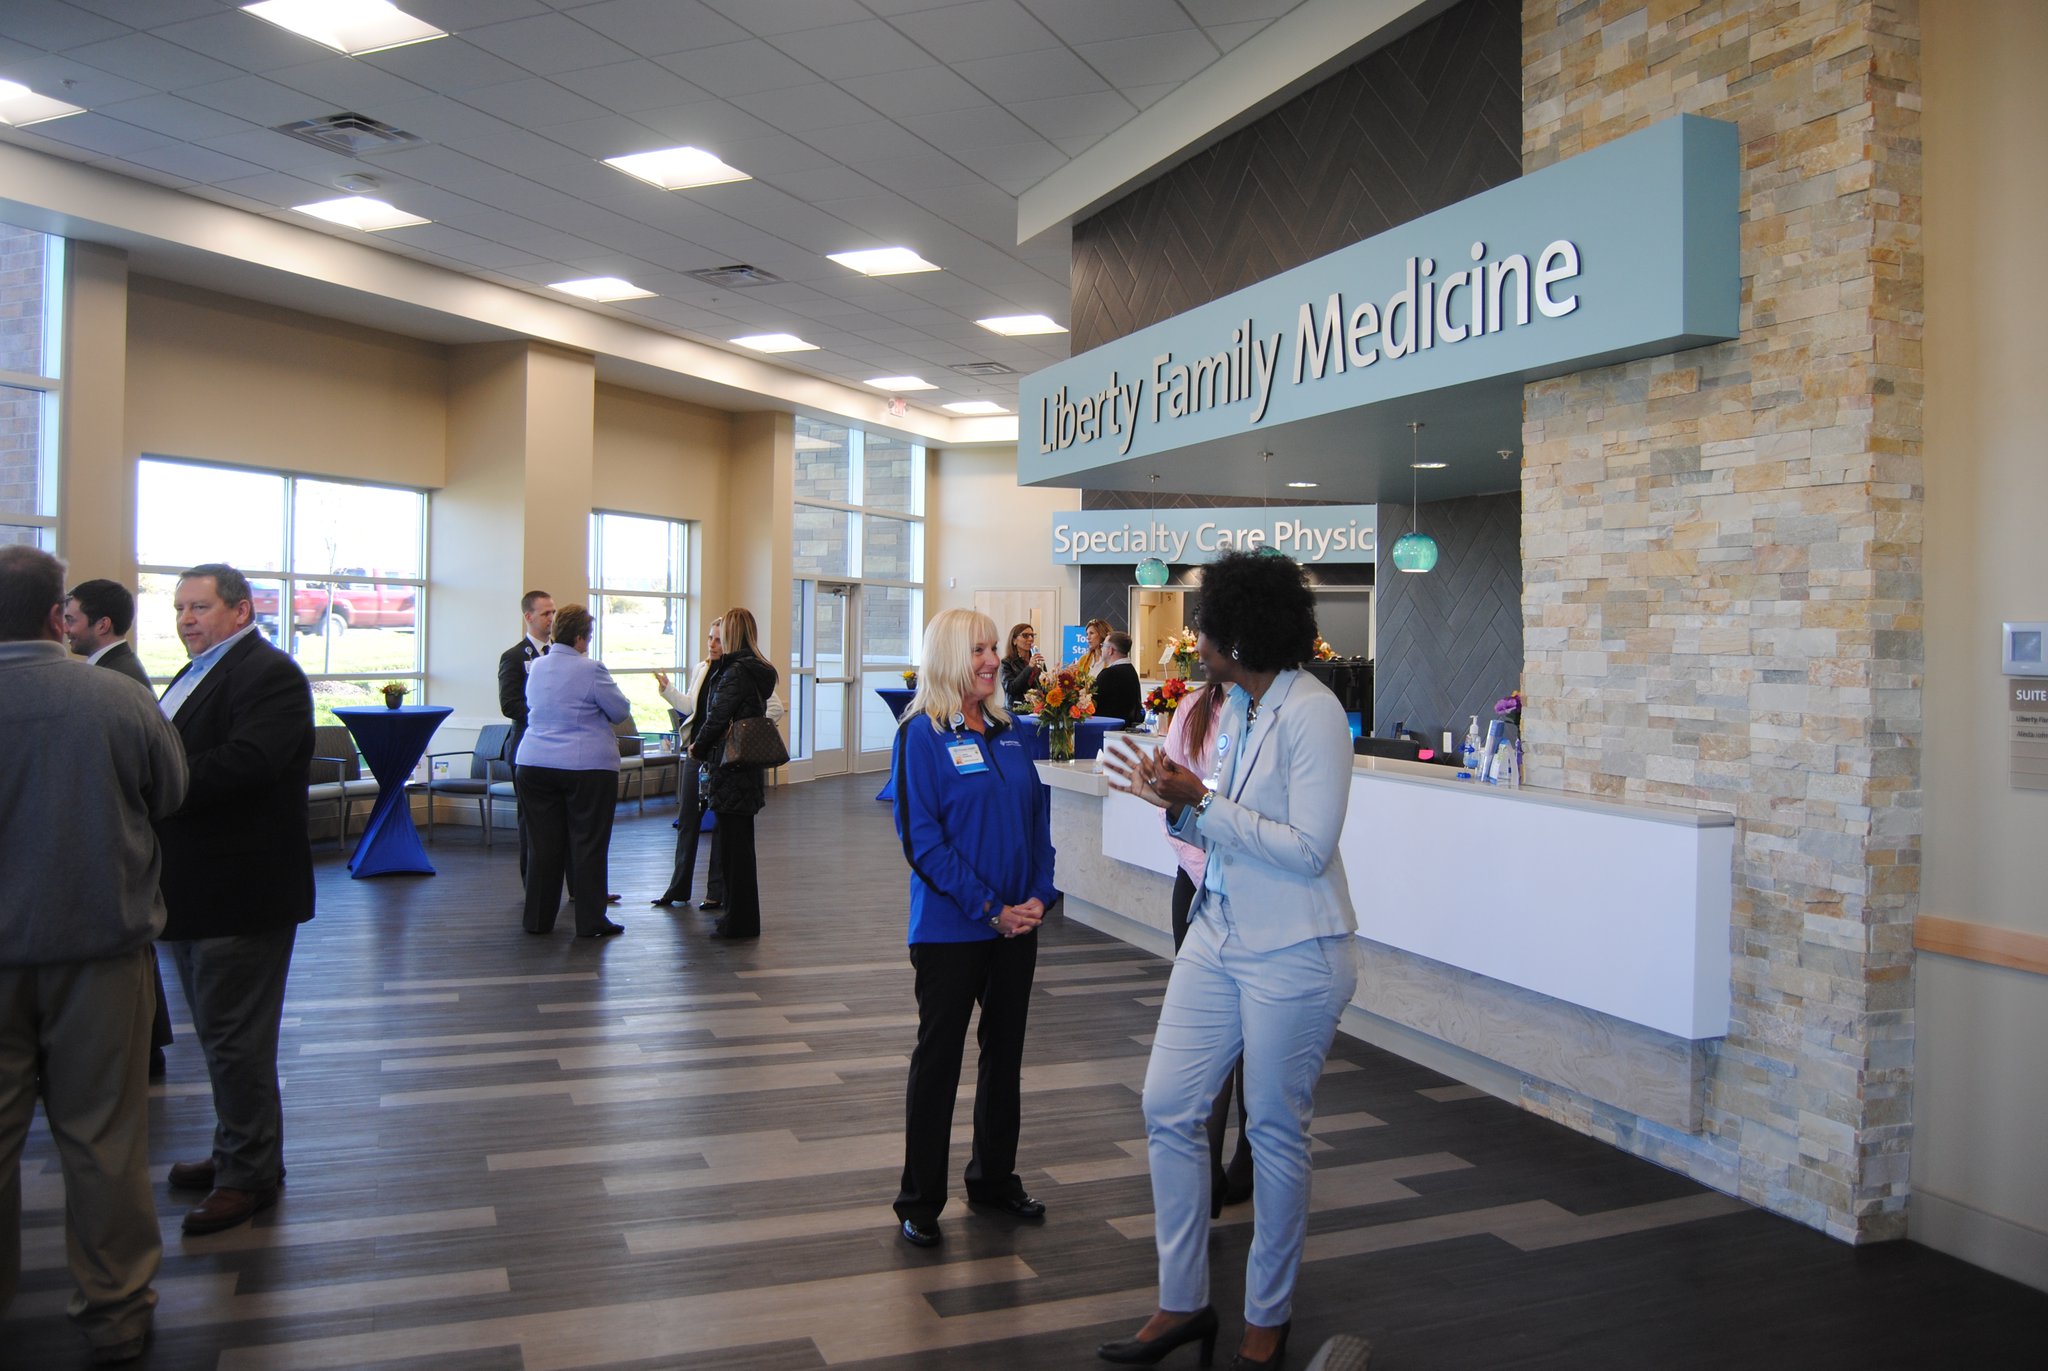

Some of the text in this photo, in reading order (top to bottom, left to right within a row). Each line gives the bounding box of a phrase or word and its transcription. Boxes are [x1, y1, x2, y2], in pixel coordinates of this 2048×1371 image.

[1040, 239, 1582, 455] Liberty Family Medicine
[1053, 519, 1374, 561] Specialty Care Physic
[2015, 689, 2047, 701] SUITE
